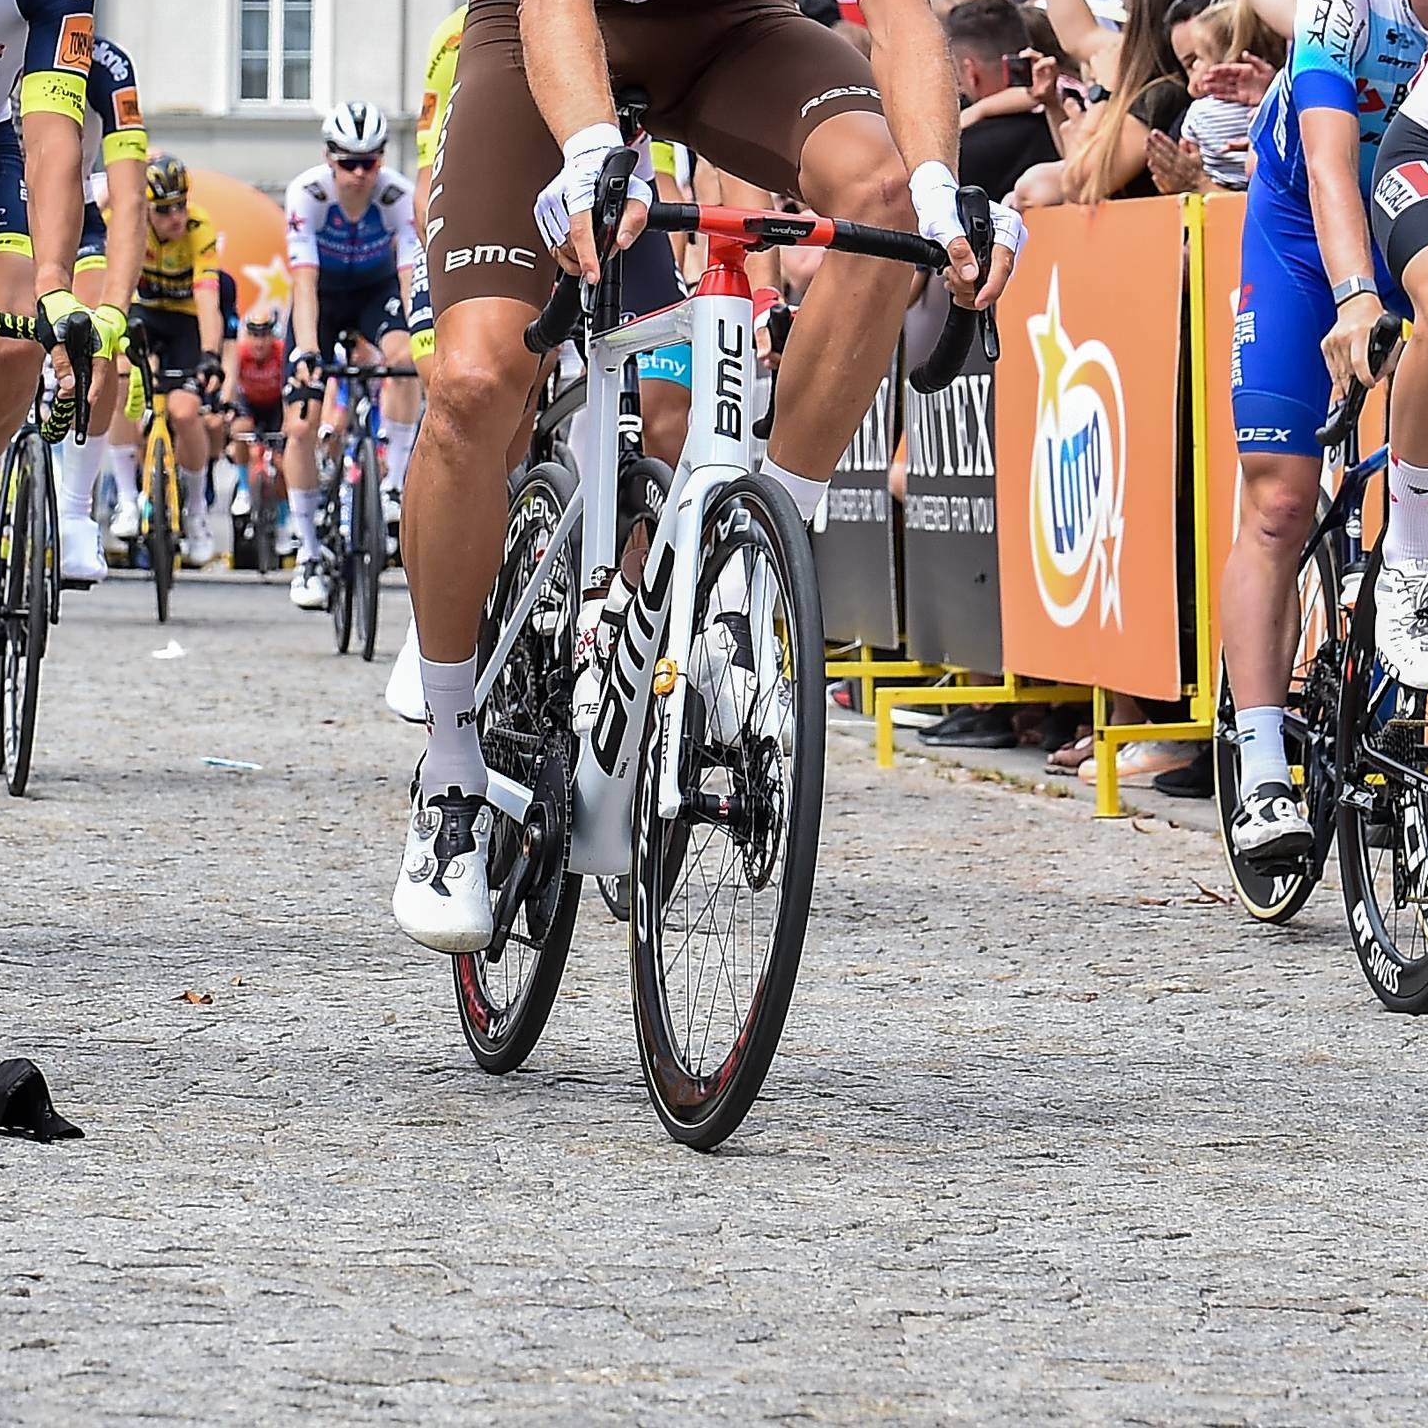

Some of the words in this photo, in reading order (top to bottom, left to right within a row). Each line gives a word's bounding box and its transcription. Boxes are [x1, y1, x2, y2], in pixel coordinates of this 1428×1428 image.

[770, 226, 807, 237] wahoo
[445, 245, 536, 272] BMC
[1240, 311, 1256, 344] BIKE
[636, 353, 686, 376] stny
[714, 318, 744, 442] BMC
[1235, 428, 1291, 441] DEX
[1047, 410, 1101, 555] LOTTO
[1367, 941, 1403, 995] SWISS
